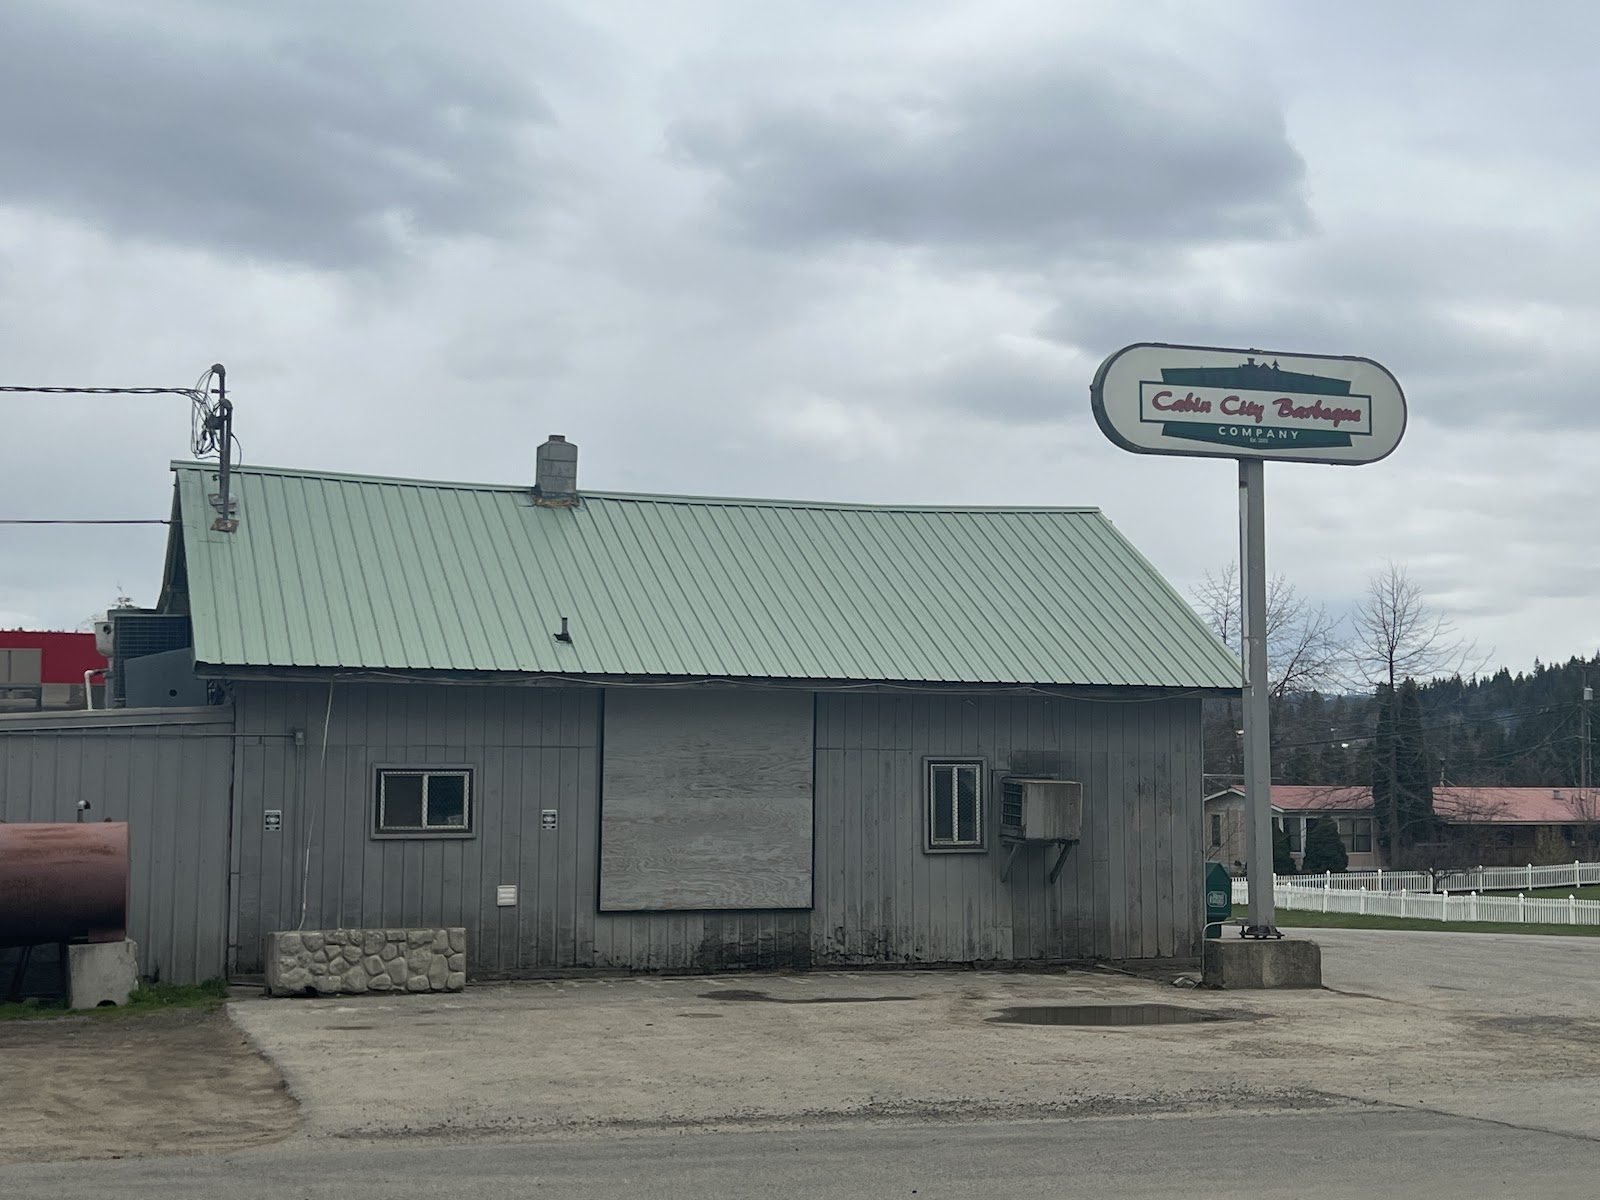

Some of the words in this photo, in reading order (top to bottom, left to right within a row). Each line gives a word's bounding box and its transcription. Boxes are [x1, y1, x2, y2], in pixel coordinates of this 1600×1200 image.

[1152, 391, 1211, 413] Cabin
[1220, 395, 1264, 423] City
[1272, 398, 1361, 427] Barbeque
[1218, 426, 1299, 440] COMPANY
